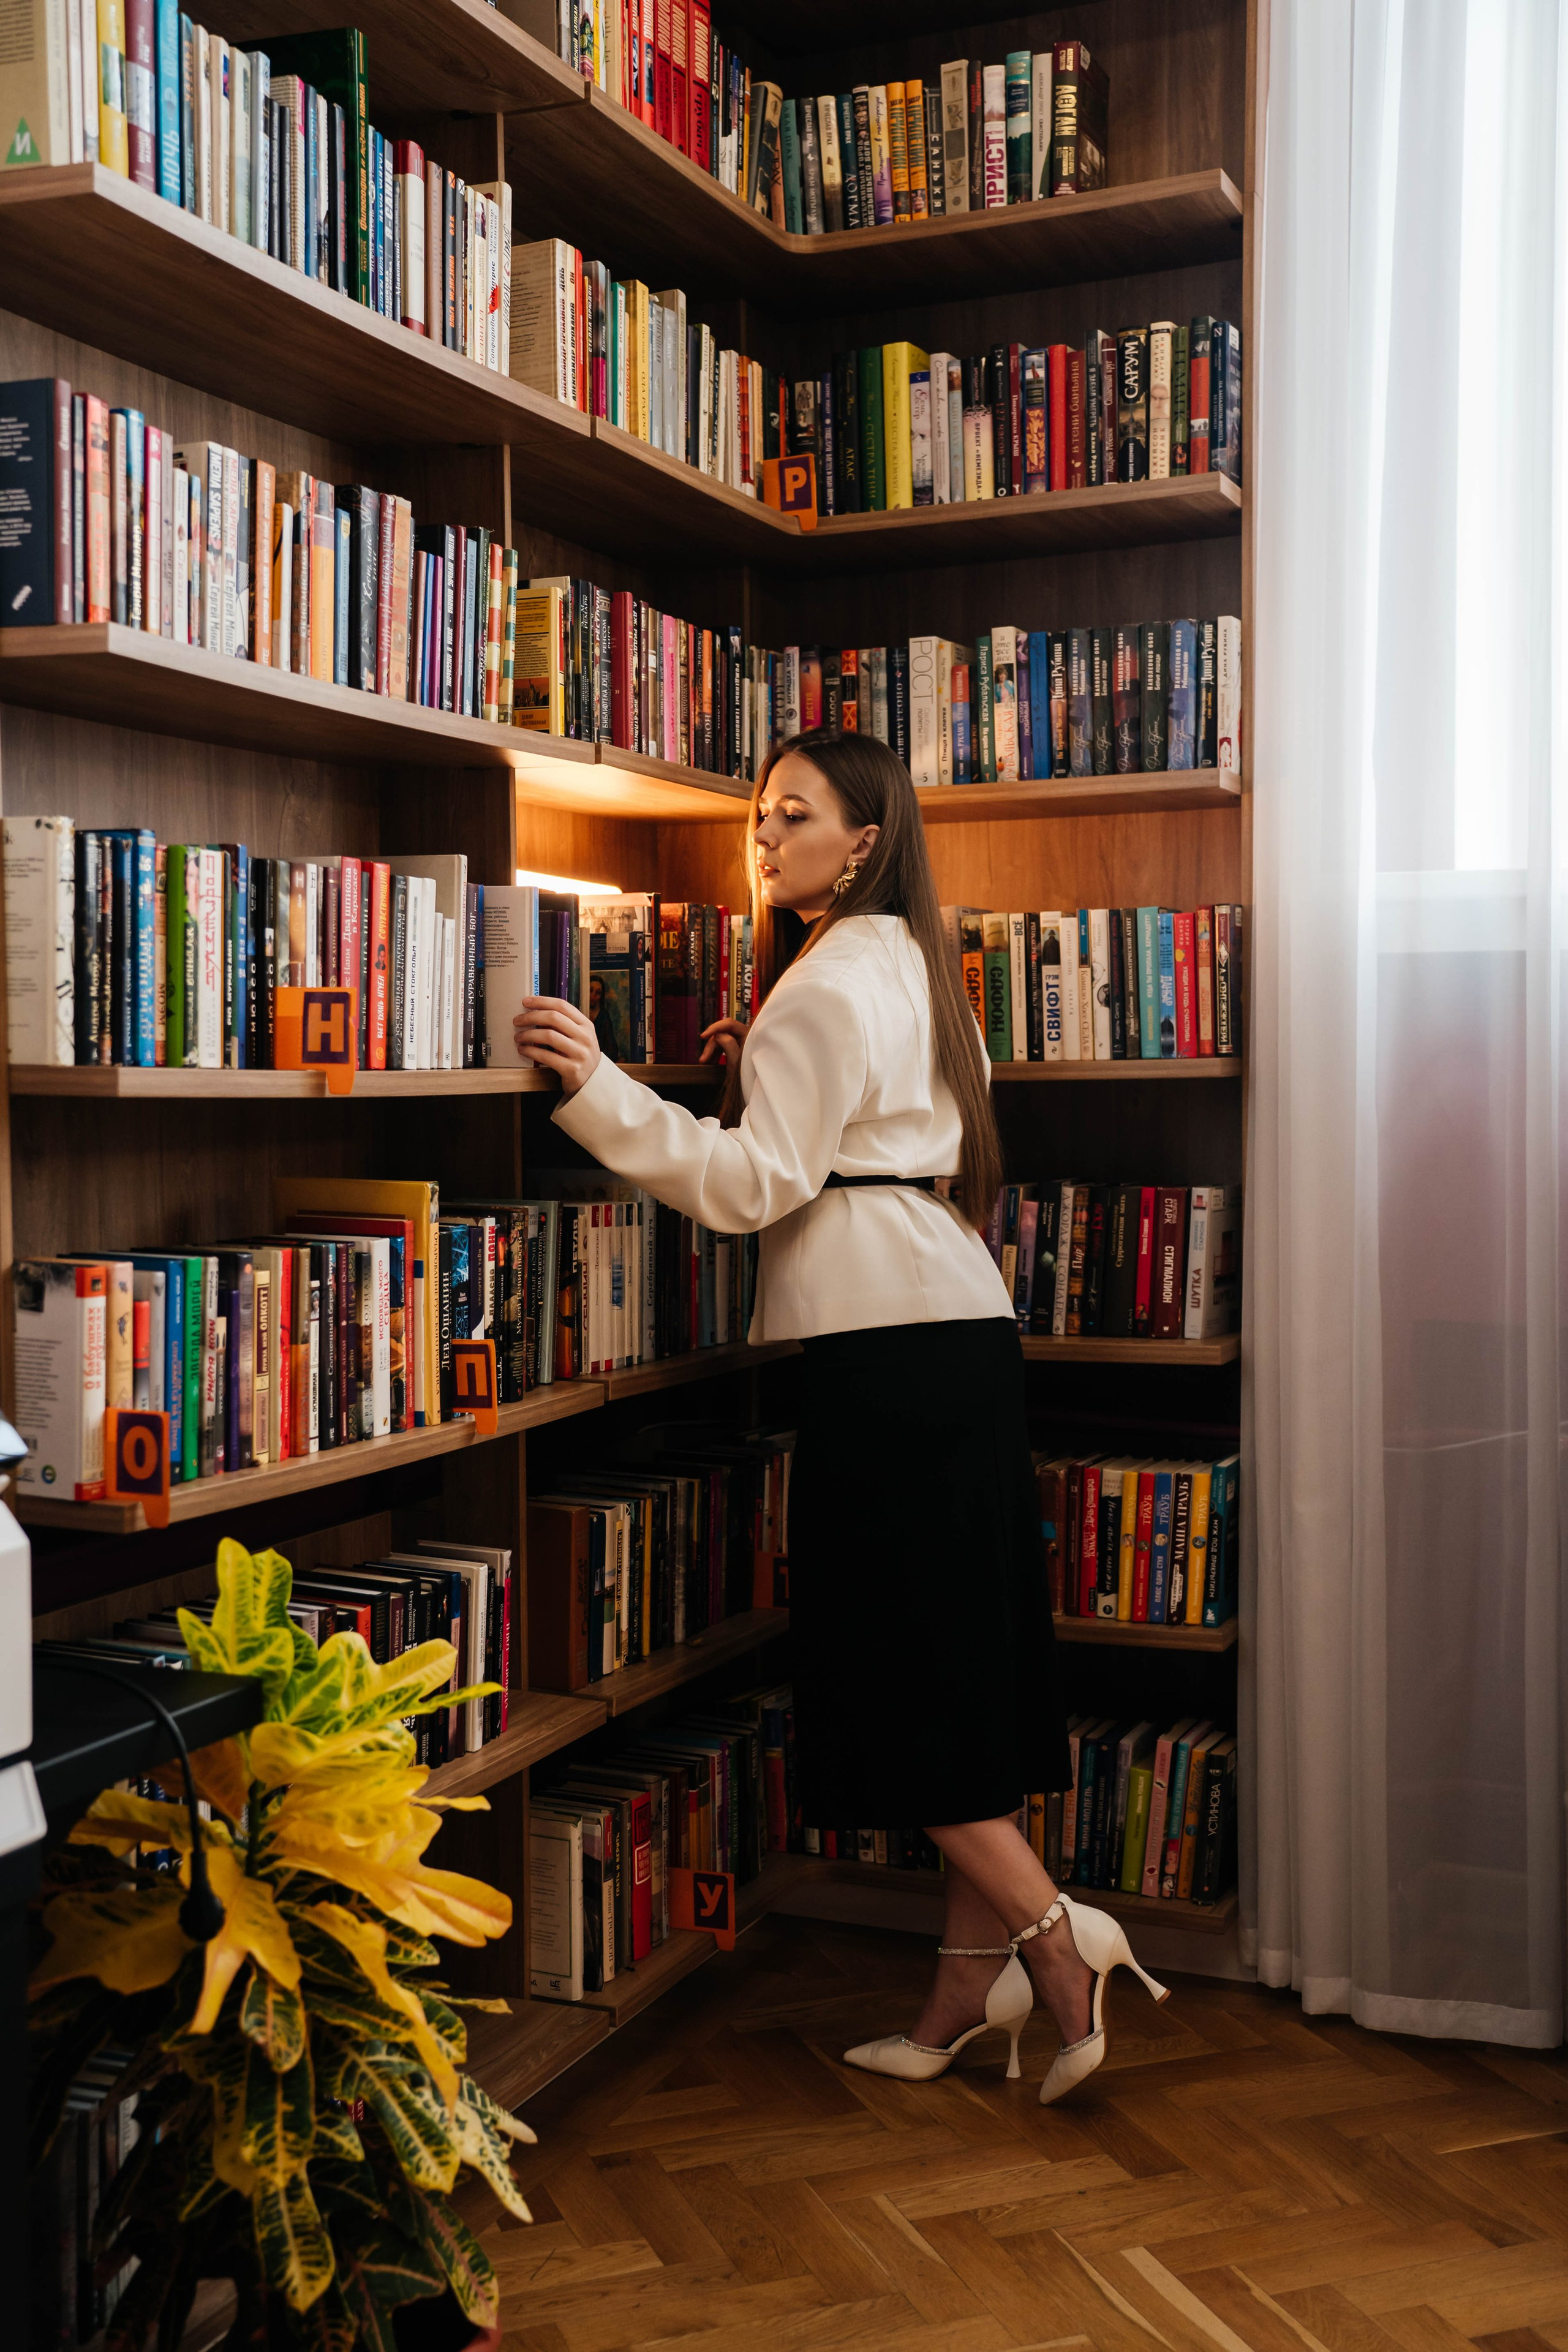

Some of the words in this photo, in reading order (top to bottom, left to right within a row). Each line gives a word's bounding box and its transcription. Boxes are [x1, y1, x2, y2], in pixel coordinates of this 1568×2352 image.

[785, 467, 807, 501] Р
[308, 1003, 344, 1052] Н
[1046, 982, 1061, 1041] СВИФТ
[455, 1354, 488, 1395] П
[123, 1426, 158, 1479] О
[698, 1882, 723, 1917] У
